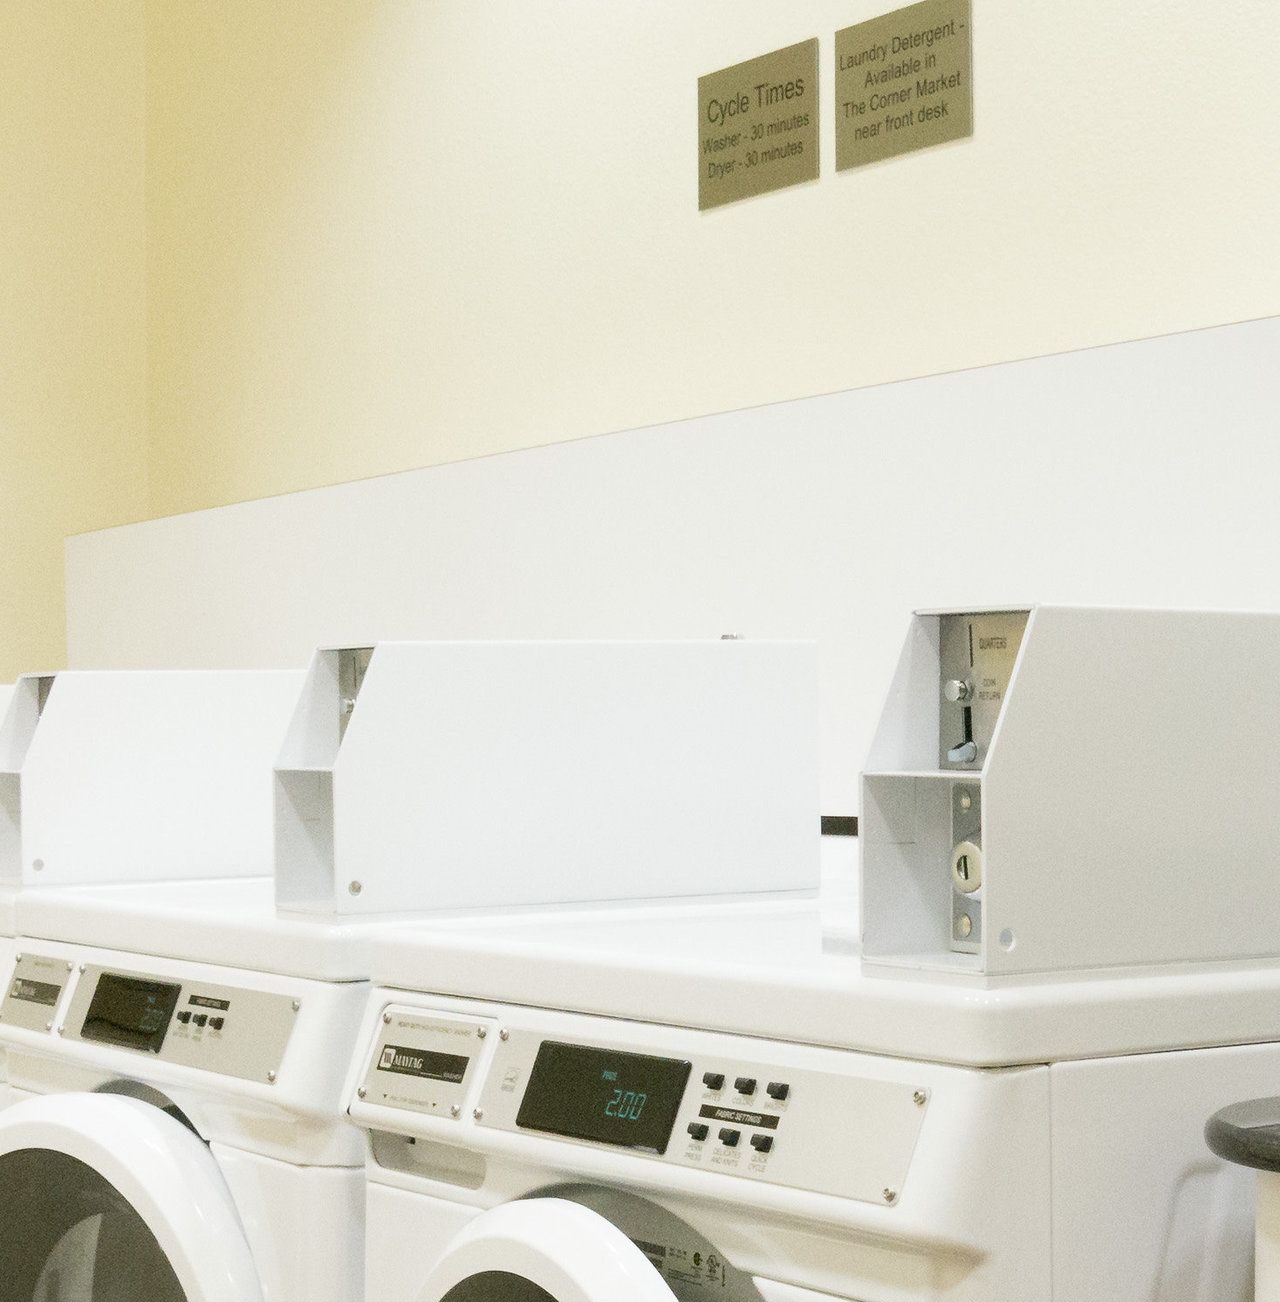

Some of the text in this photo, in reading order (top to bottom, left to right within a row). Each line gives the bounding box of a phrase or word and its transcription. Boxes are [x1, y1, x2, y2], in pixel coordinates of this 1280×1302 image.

[840, 43, 888, 72] Laundry
[892, 22, 956, 54] Detergent
[865, 53, 936, 88] Available in
[708, 79, 804, 126] Cycle Times
[842, 71, 961, 118] The Corner Market
[703, 133, 741, 155] Washer
[750, 123, 764, 141] 30
[767, 114, 809, 136] minutes
[854, 100, 949, 141] near front desk
[708, 160, 736, 179] Dryer
[744, 150, 759, 169] 30
[761, 141, 804, 163] minutes
[393, 1055, 424, 1069] MAYTAG
[605, 1089, 647, 1120] 2.00
